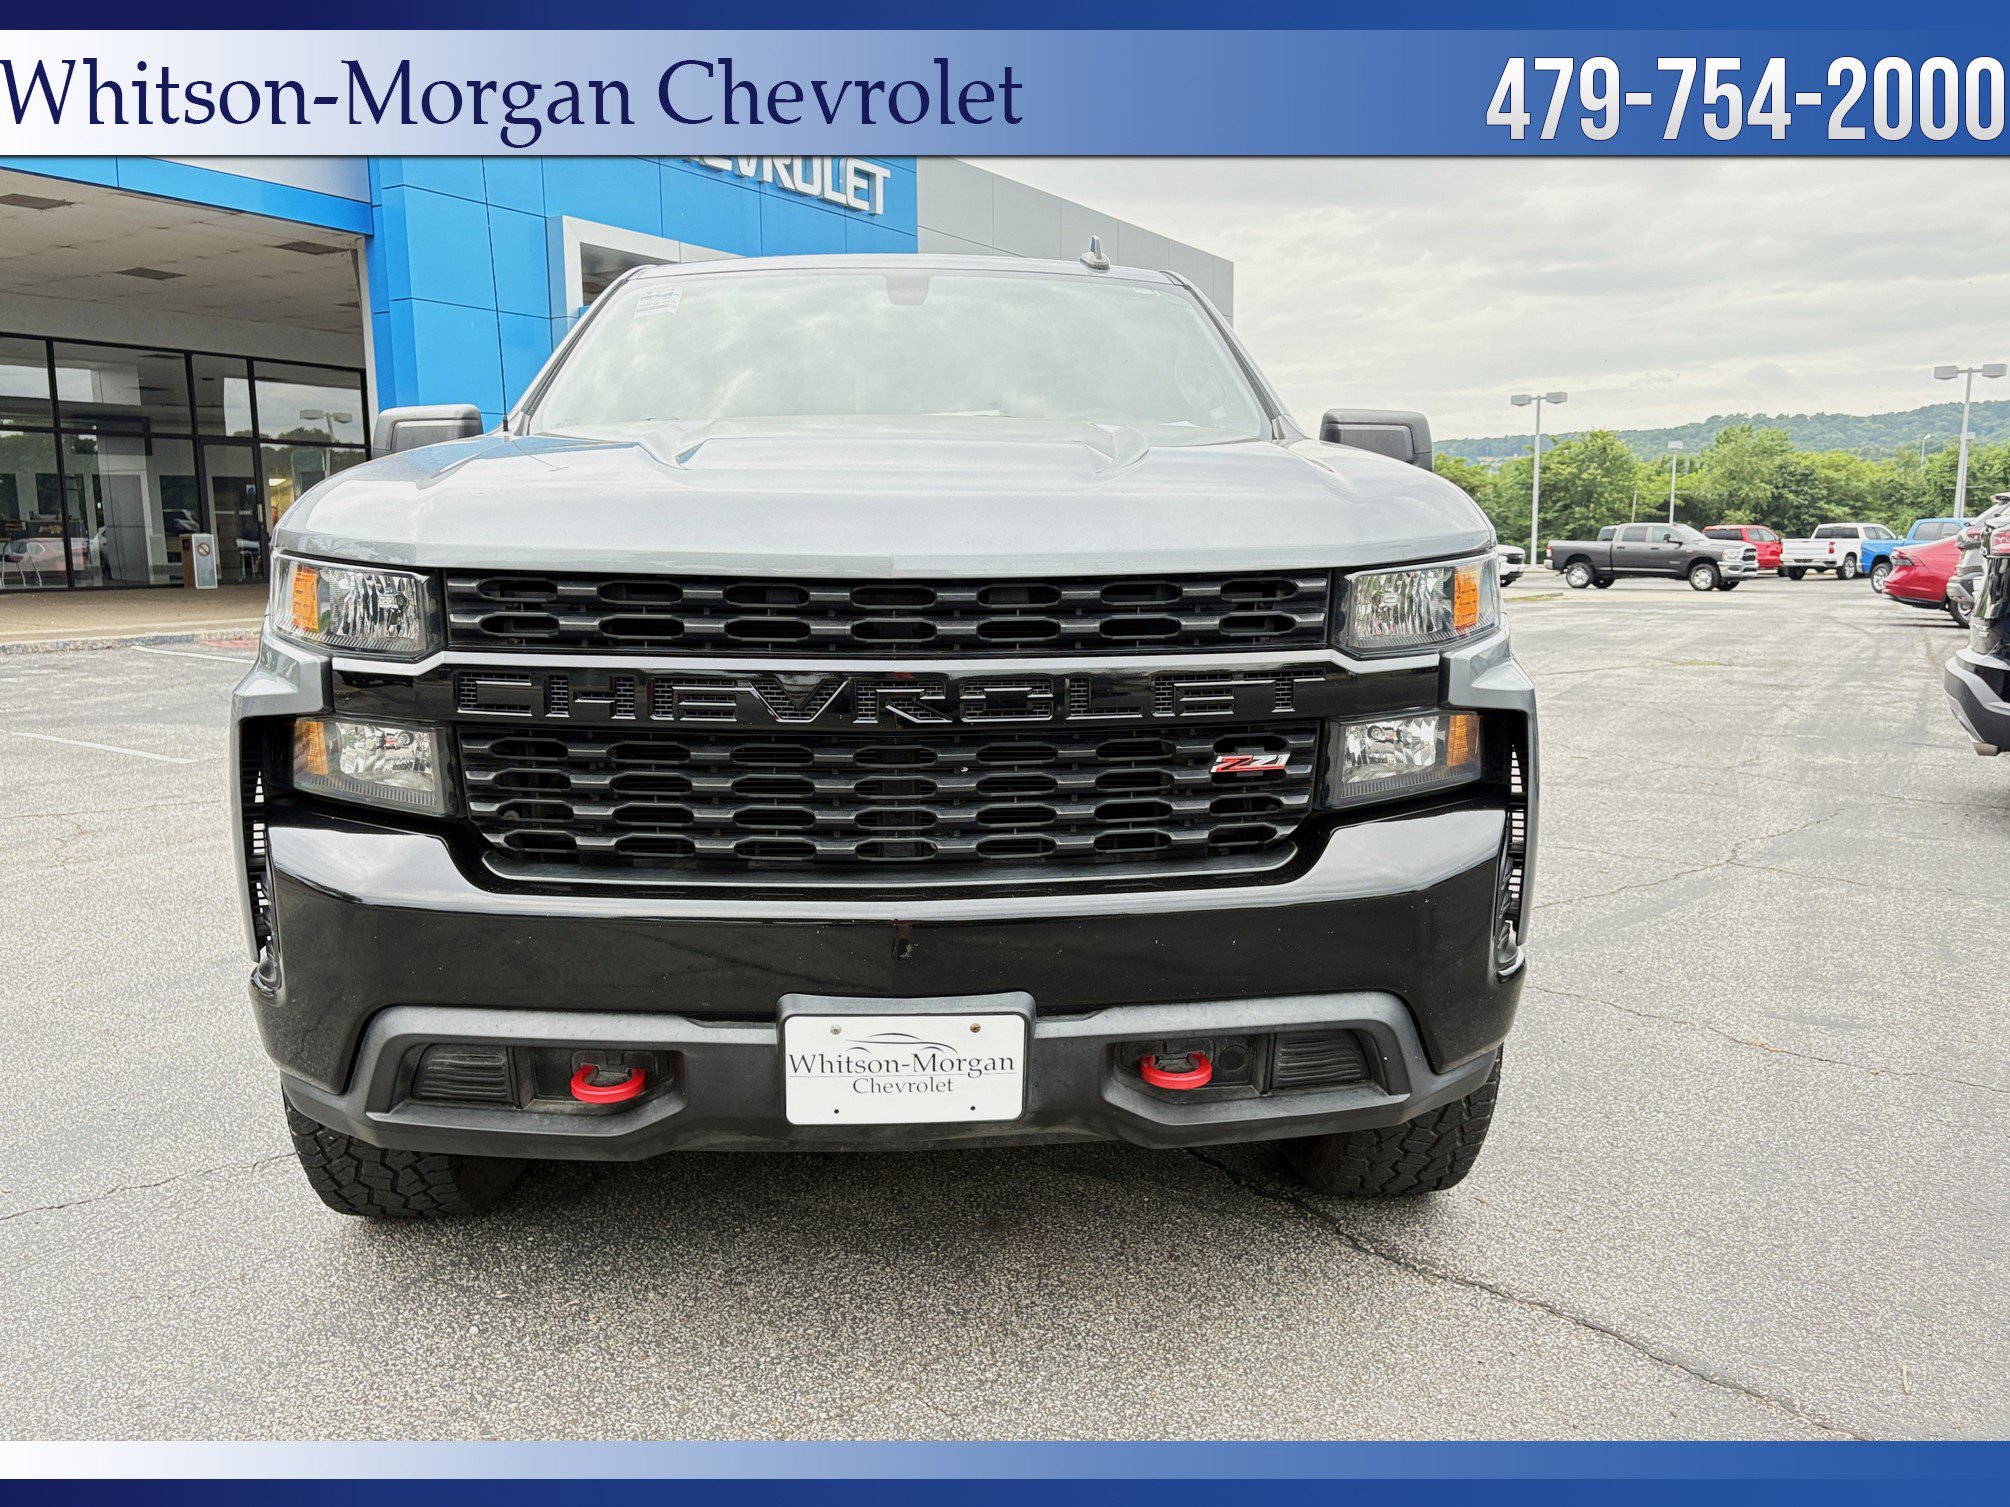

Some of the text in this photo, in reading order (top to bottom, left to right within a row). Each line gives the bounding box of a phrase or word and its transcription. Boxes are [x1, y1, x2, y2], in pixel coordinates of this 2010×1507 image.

[687, 155, 891, 215] ROLET
[456, 671, 1327, 724] CHEVROLET
[1210, 752, 1291, 773] Z71
[788, 1052, 1015, 1079] Whitson-Morgan
[852, 1076, 954, 1094] Chevrolet
